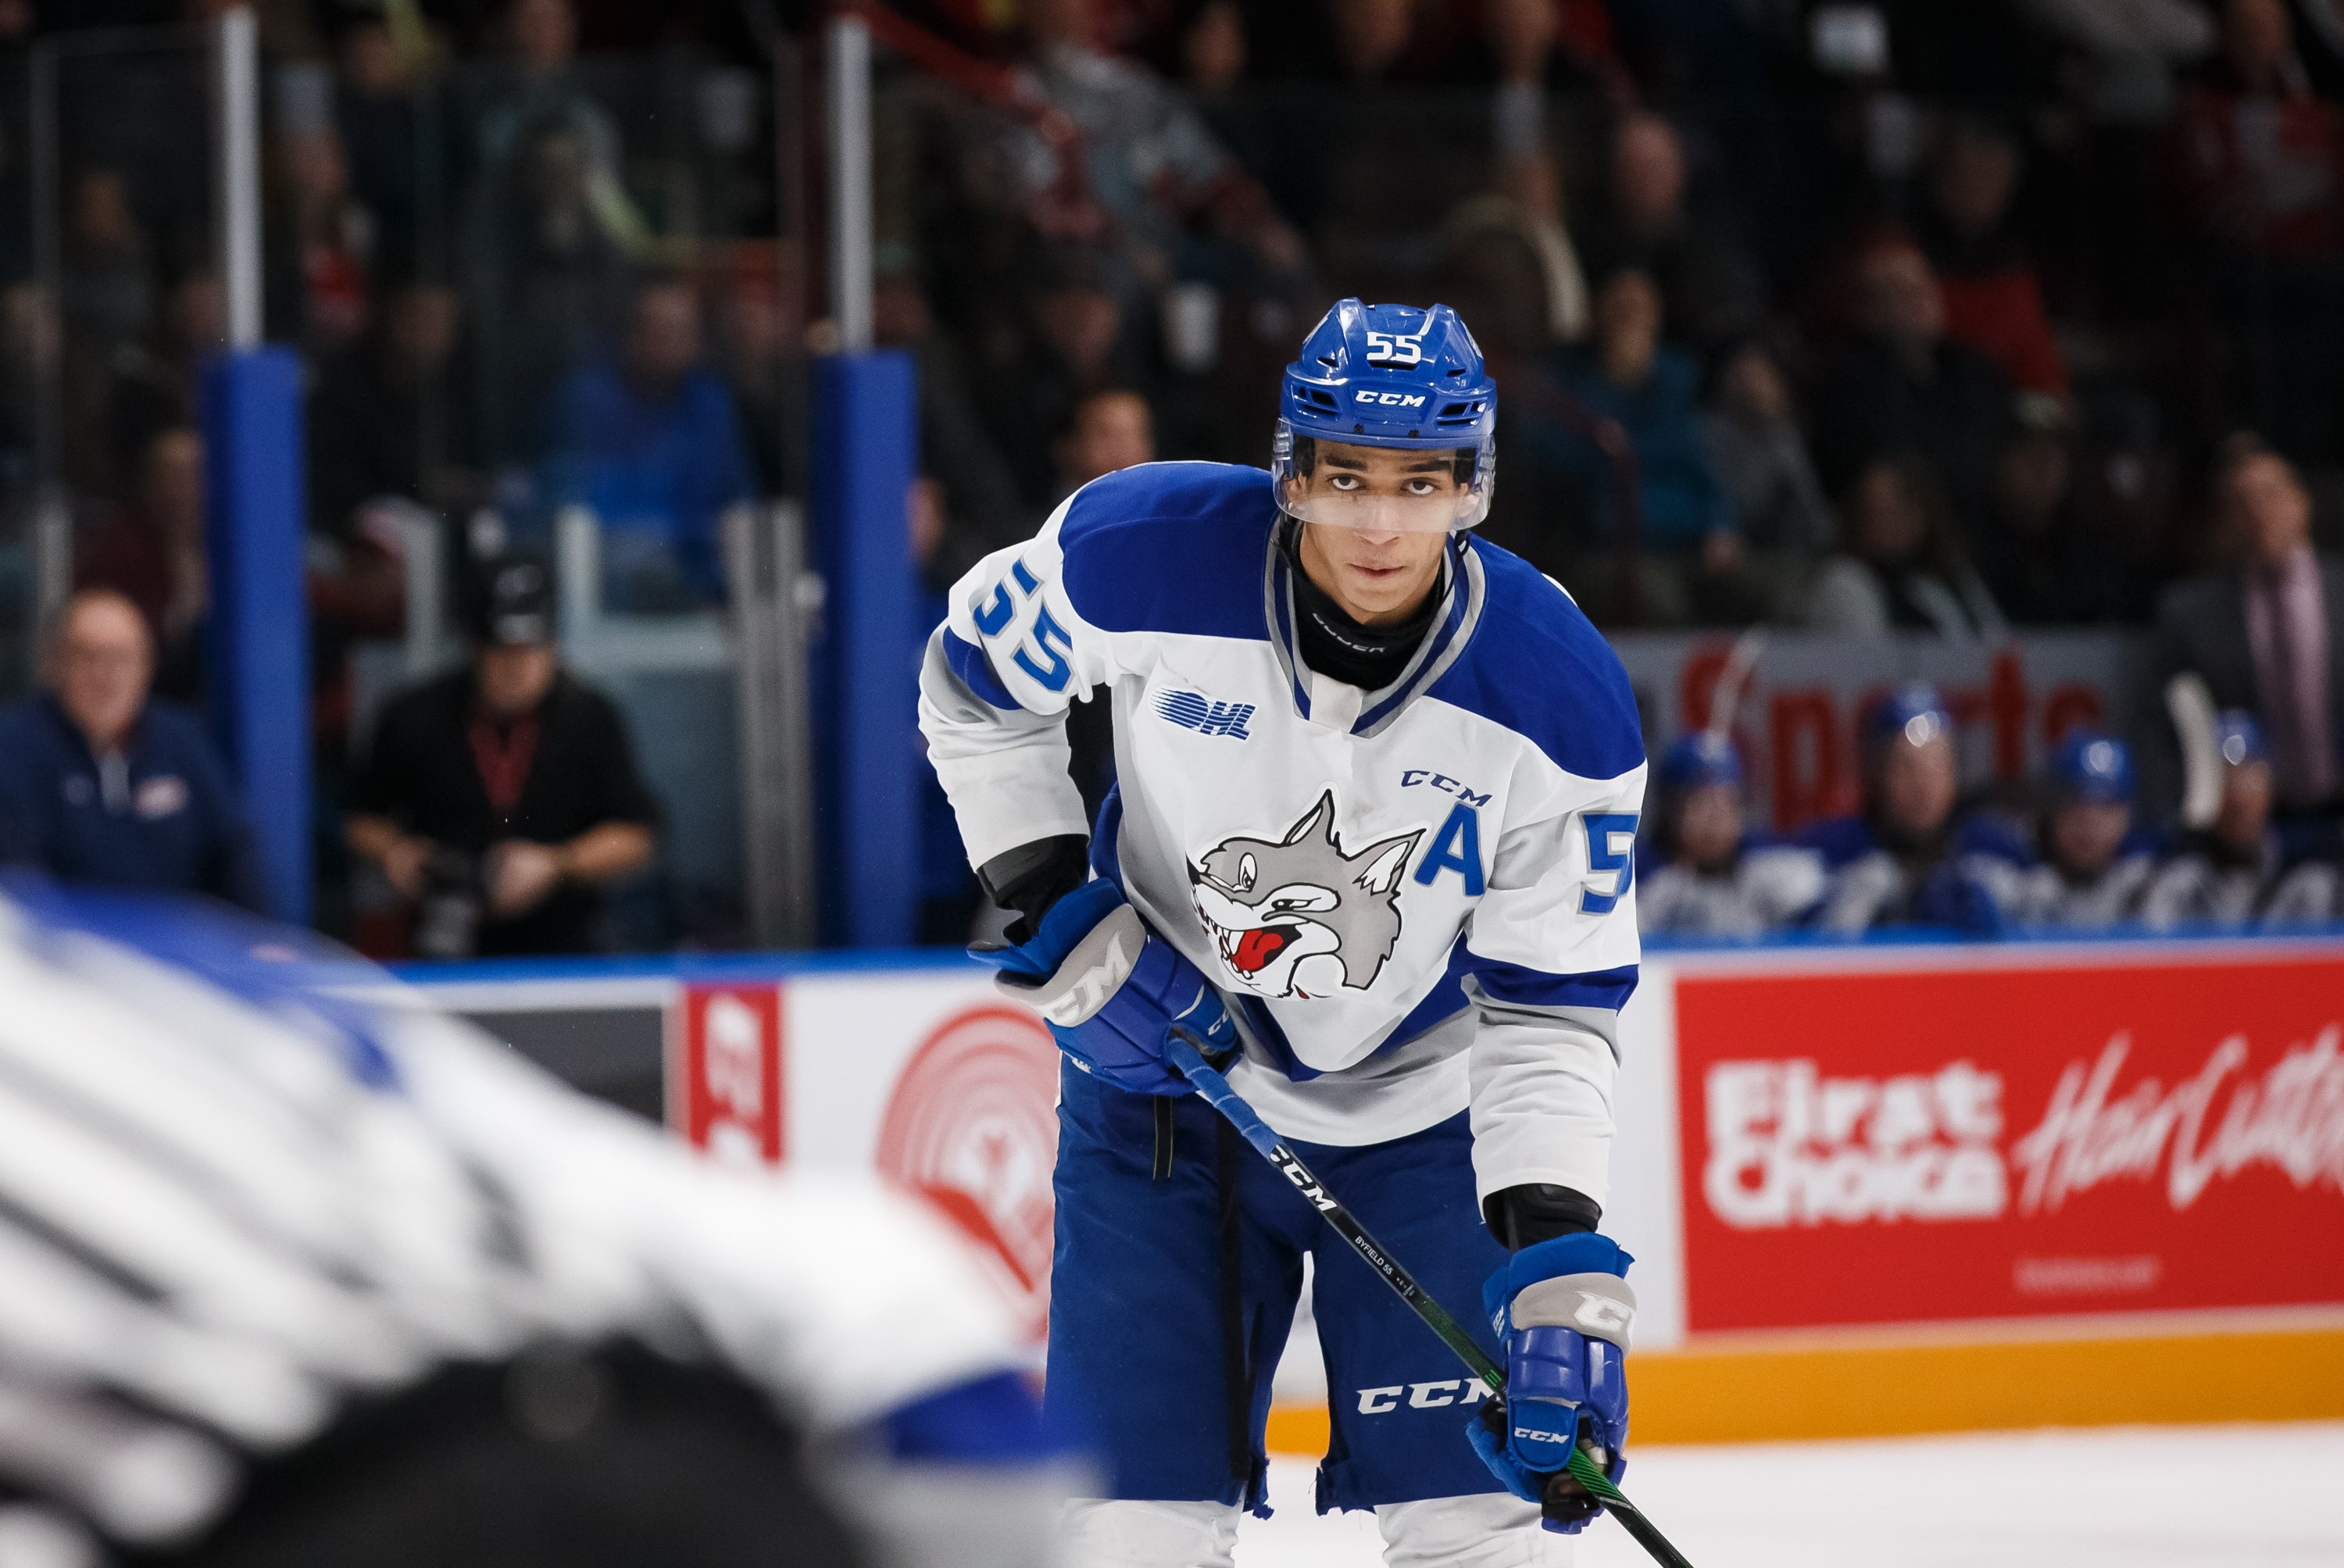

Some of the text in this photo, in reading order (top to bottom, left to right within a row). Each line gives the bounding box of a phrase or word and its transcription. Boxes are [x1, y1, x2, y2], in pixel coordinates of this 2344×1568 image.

[1367, 333, 1422, 363] 55
[1356, 391, 1426, 407] CCM
[973, 555, 1075, 695] 55
[1401, 770, 1493, 807] CCM
[1413, 801, 1485, 897] A
[1355, 1236, 1393, 1275] BYFIELD 55
[1514, 1427, 1570, 1445] CCM
